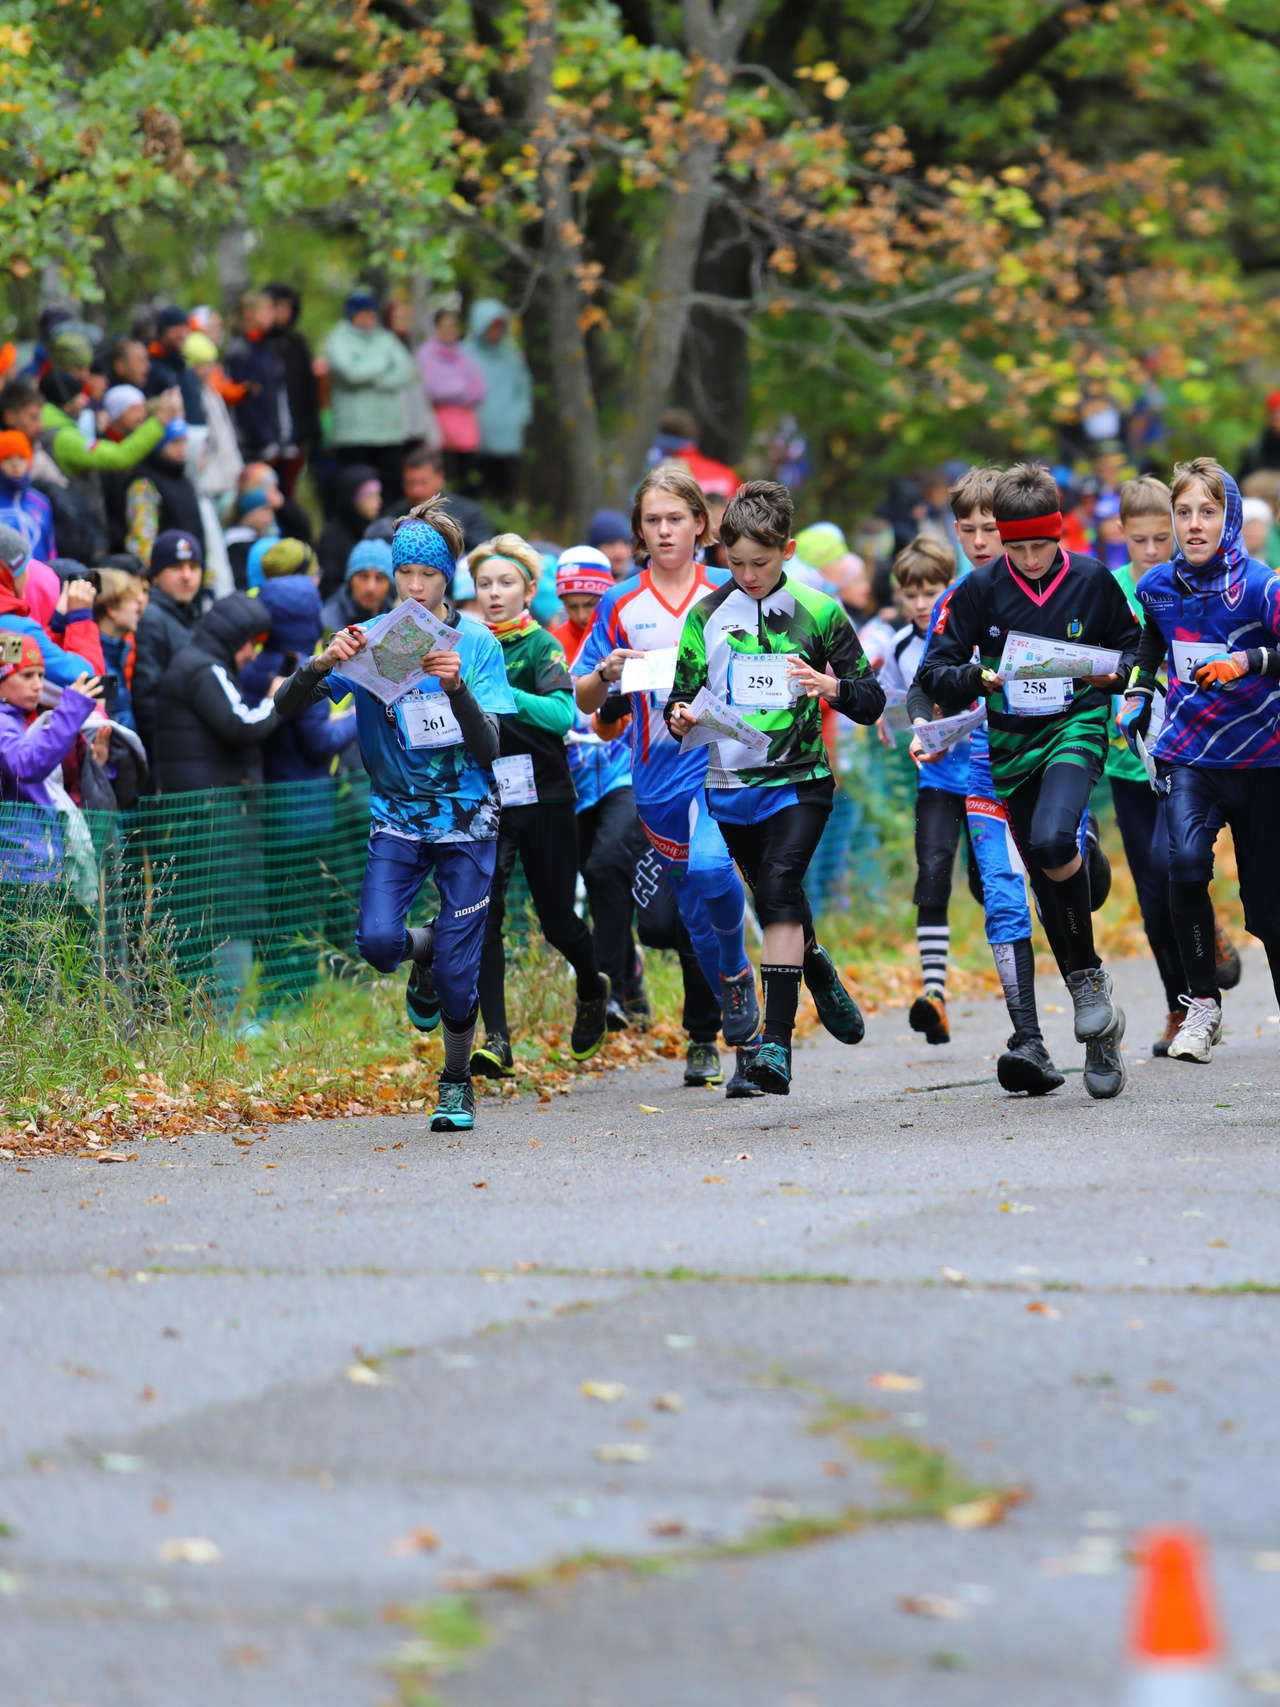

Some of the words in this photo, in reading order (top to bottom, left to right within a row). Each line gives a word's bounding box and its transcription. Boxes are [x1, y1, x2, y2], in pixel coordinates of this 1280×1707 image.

[748, 676, 773, 689] 259
[1023, 681, 1047, 694] 258
[422, 715, 446, 732] 261
